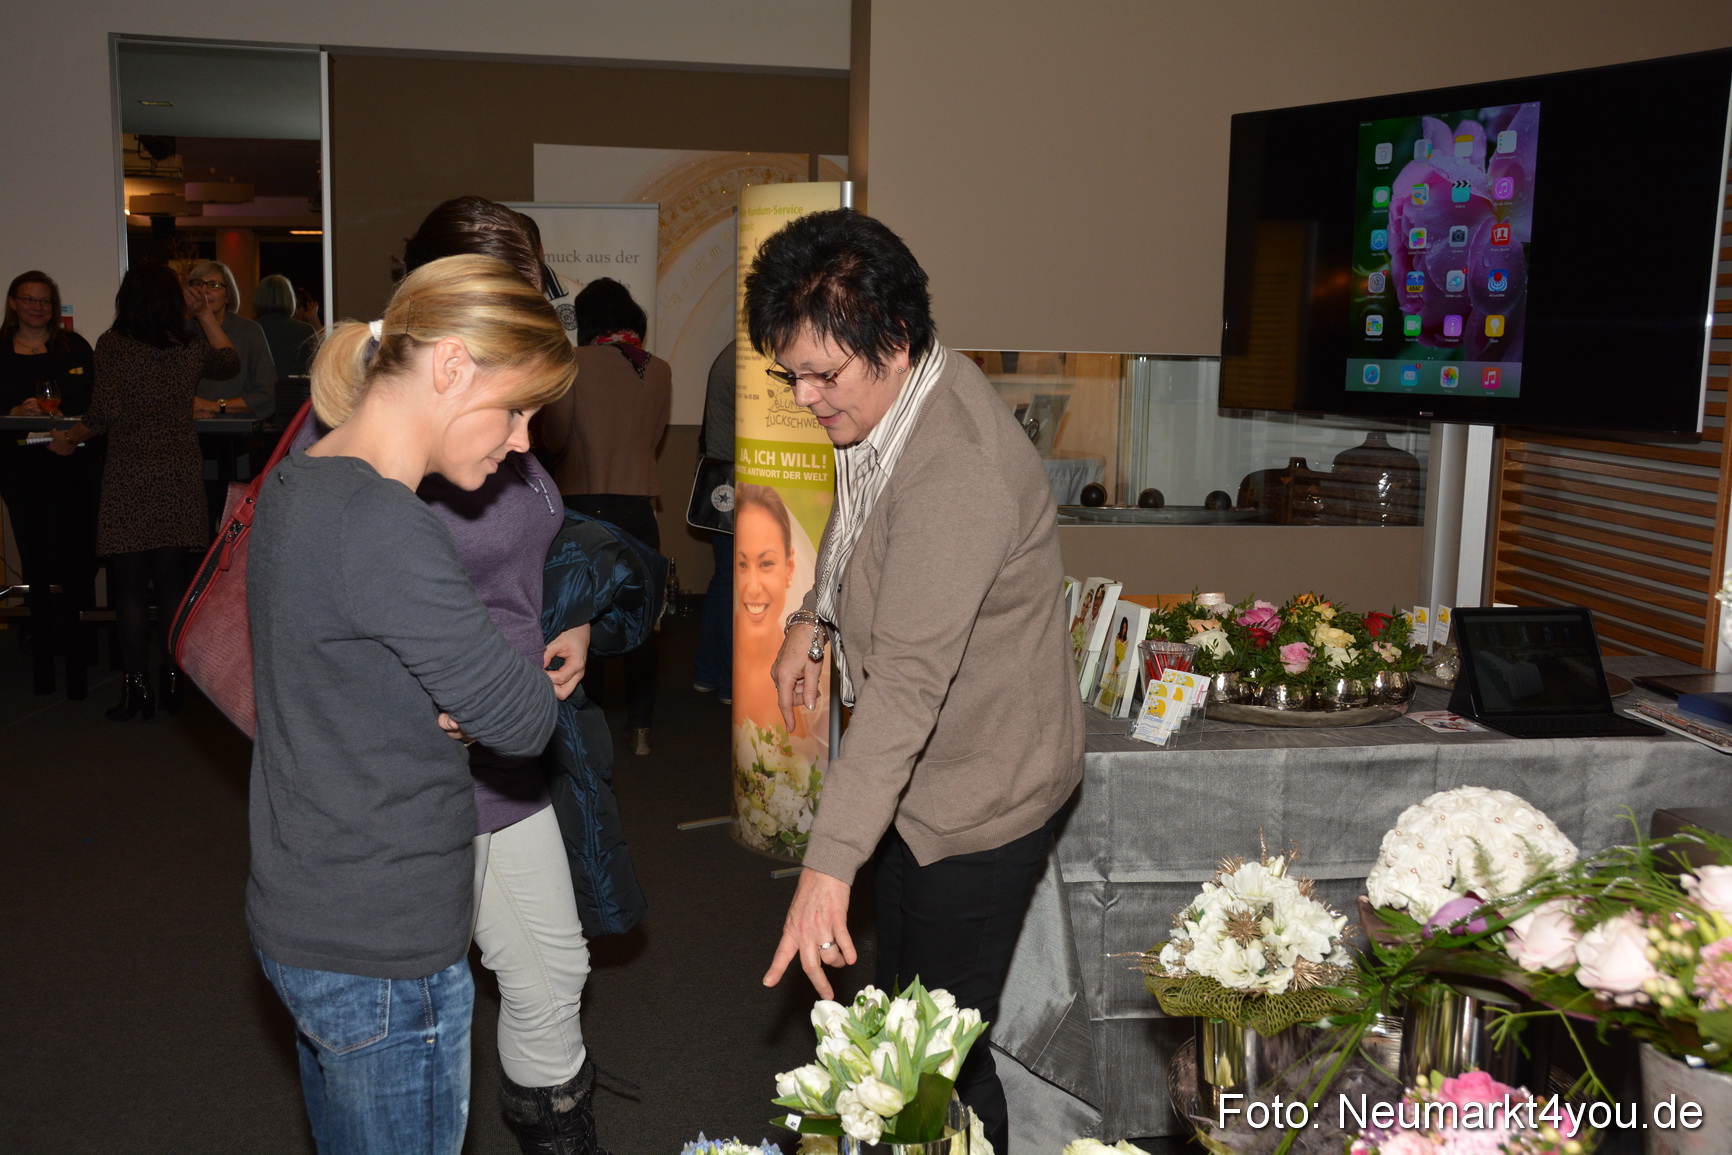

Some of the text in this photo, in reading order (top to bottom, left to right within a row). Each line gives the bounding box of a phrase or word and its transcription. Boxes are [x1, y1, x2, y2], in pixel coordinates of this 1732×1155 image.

[544, 250, 640, 263] muck aus der
[765, 413, 826, 430] ZUCKSCHWE
[740, 448, 827, 469] JA, ICH WILL!
[747, 467, 781, 479] ANTWORT
[783, 471, 801, 480] DER
[803, 472, 829, 482] WELT
